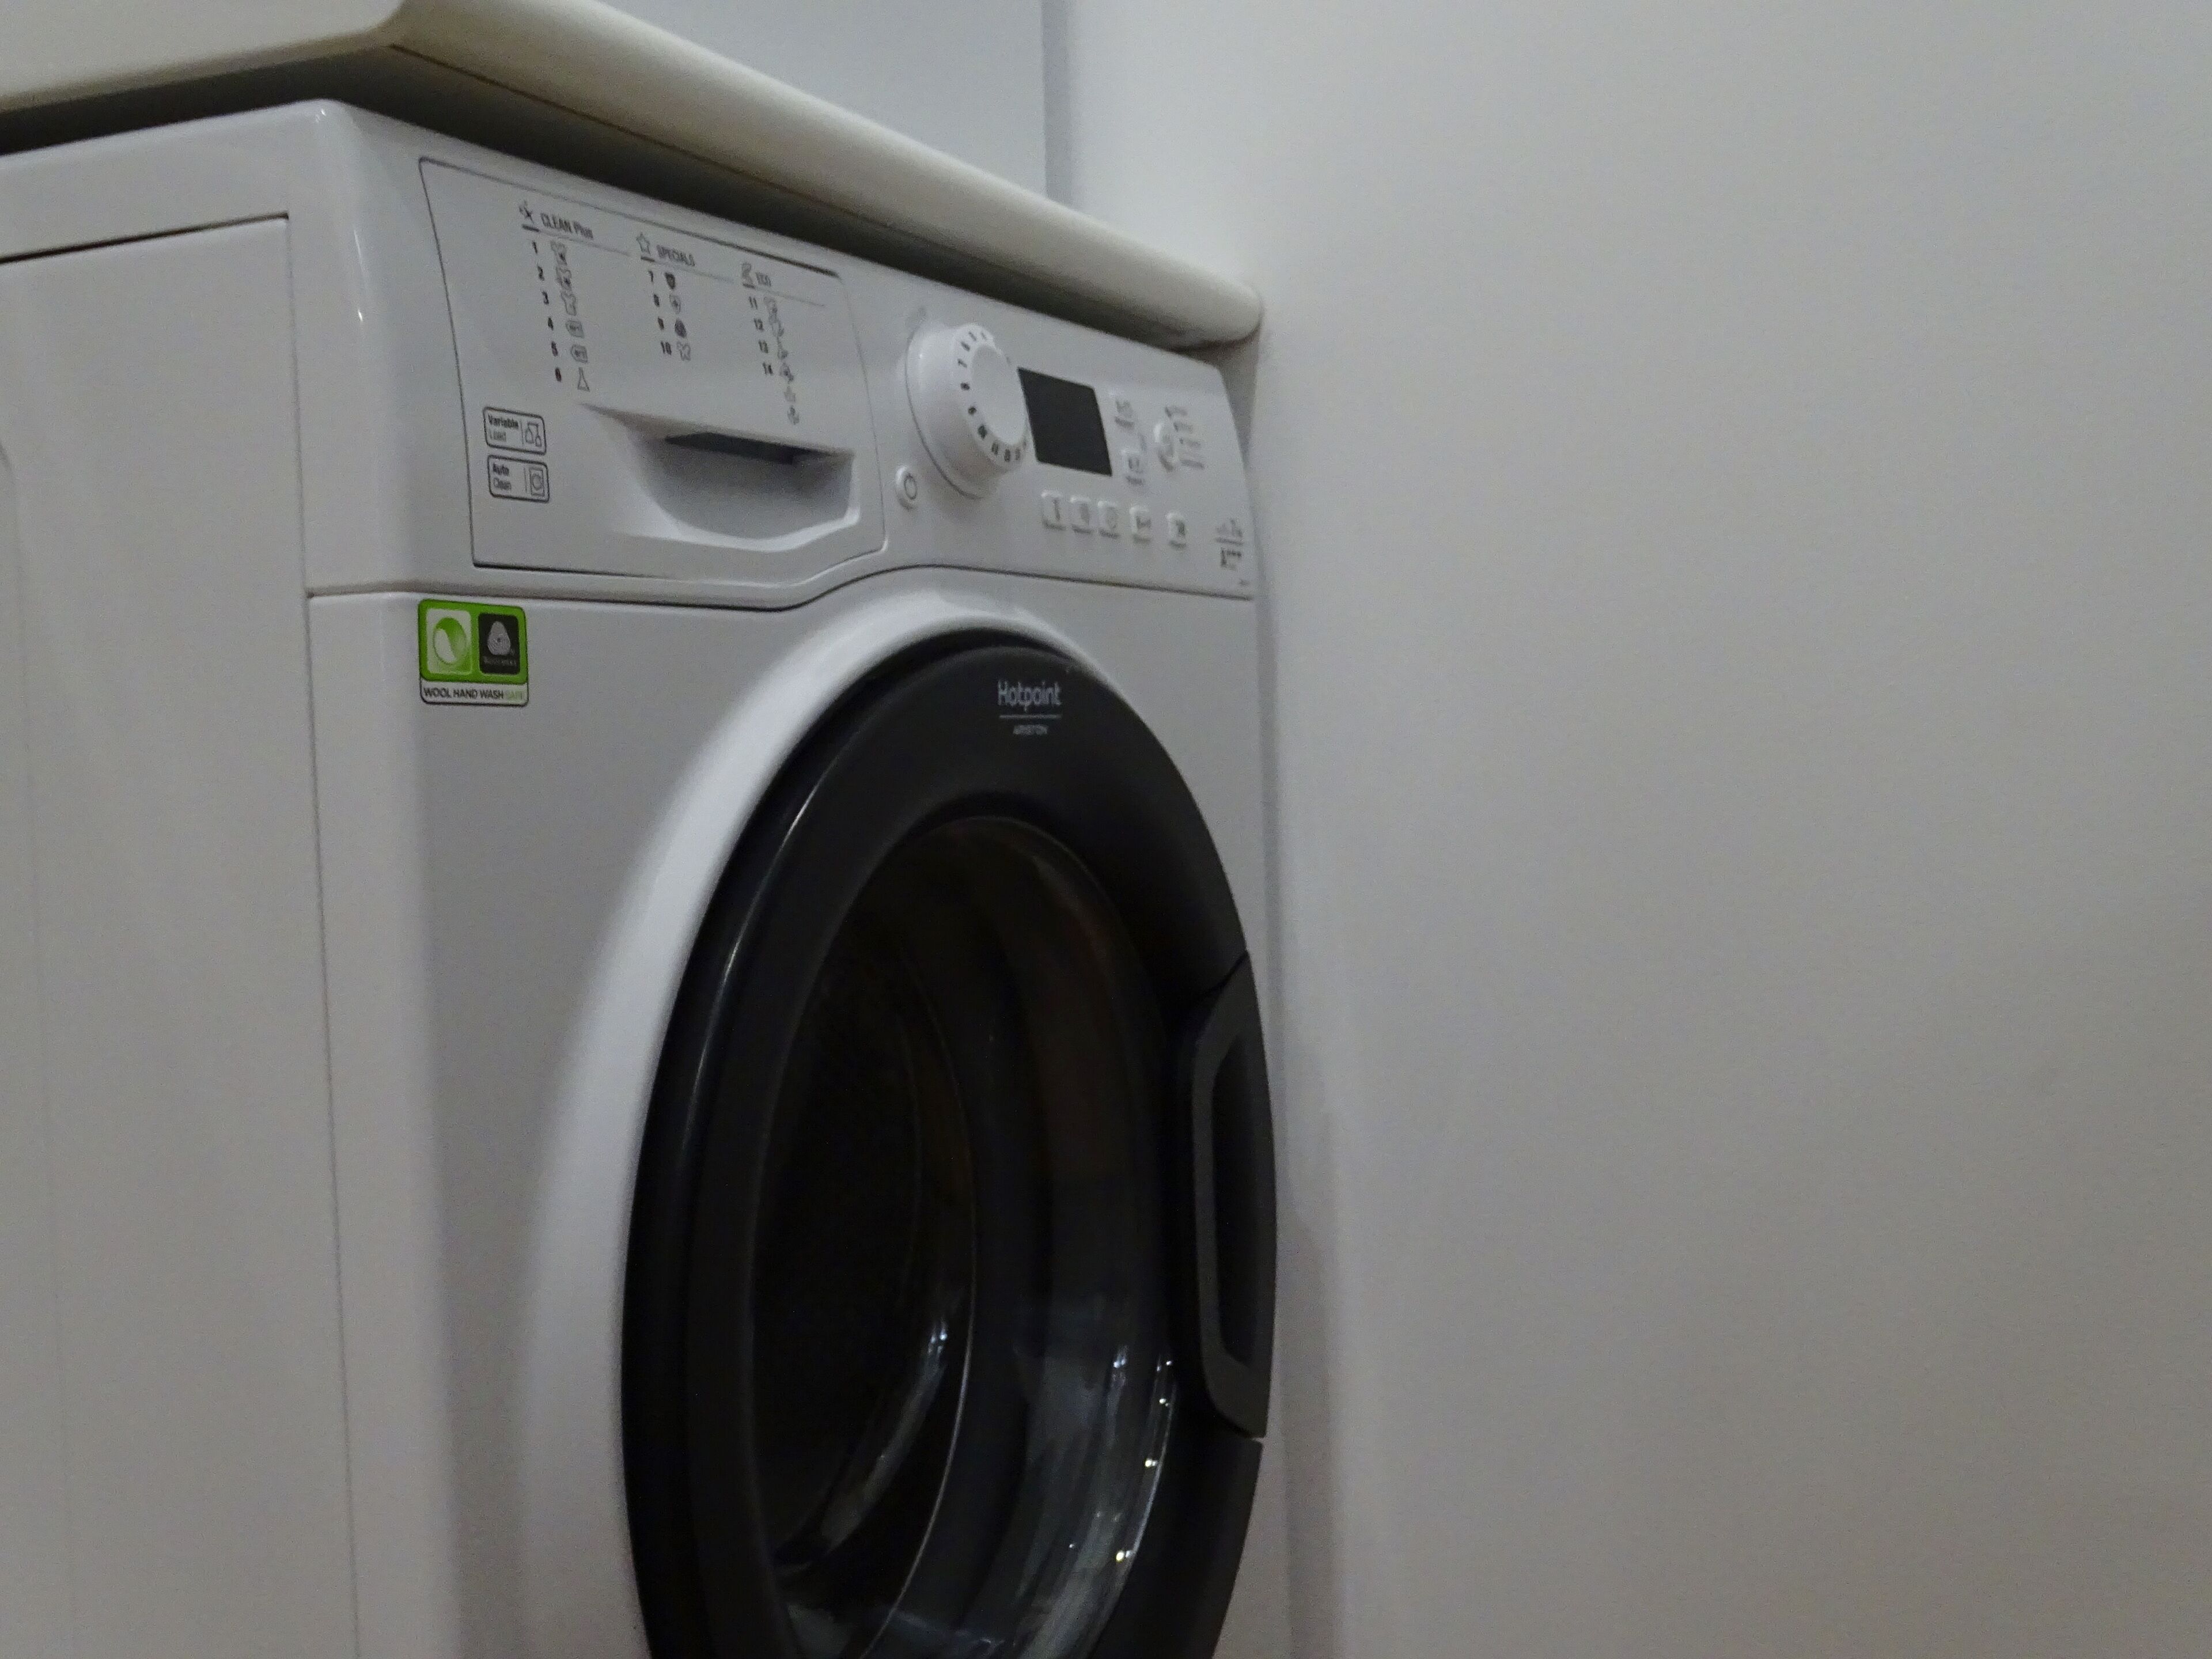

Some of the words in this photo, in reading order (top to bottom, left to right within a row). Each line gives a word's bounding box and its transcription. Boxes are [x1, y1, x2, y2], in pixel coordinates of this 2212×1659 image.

[540, 212, 572, 233] CLEAN
[532, 241, 538, 254] 1
[656, 245, 695, 266] SPECIALS
[488, 415, 518, 430] Variable
[493, 463, 510, 476] Auto
[423, 687, 452, 698] WOOL
[453, 688, 478, 699] HAND
[479, 689, 504, 699] WASH
[998, 679, 1062, 713] Hotpoint
